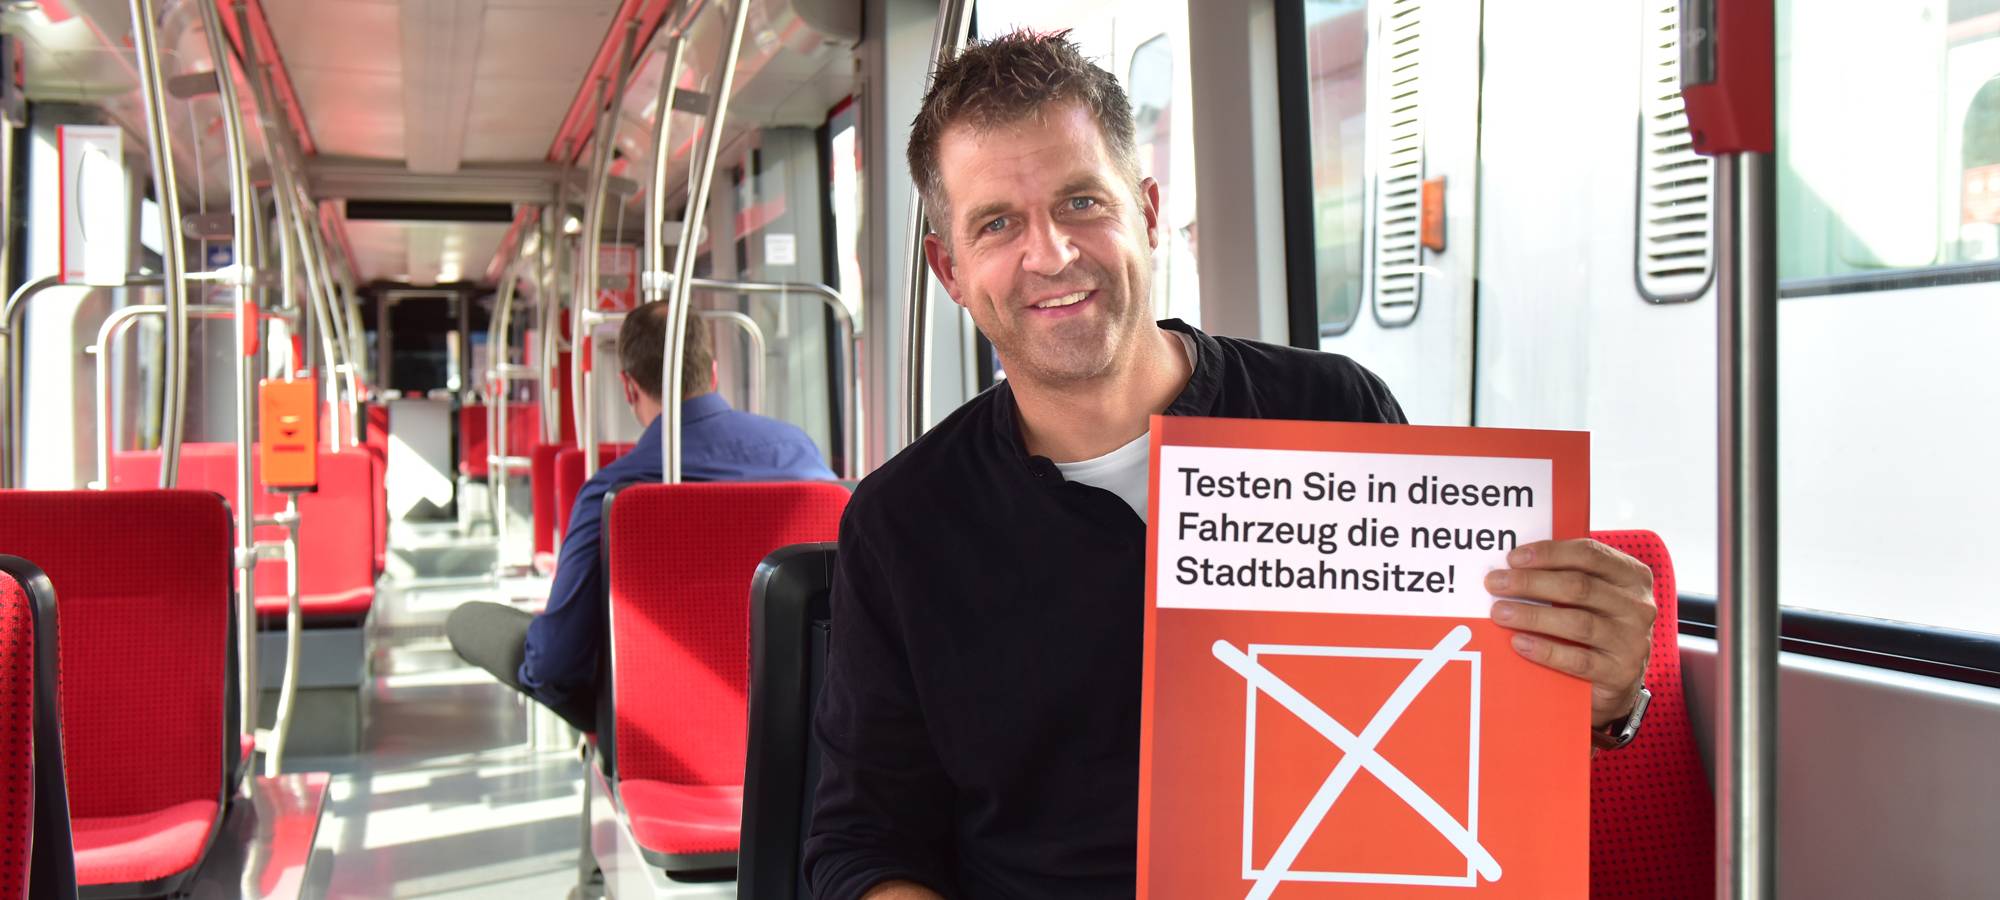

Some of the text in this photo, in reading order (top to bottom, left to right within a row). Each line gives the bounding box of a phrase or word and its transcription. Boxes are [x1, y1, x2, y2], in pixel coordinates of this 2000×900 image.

[1177, 467, 1534, 508] Testen Sie in diesem
[1178, 511, 1517, 555] Fahrzeug die neuen
[1175, 555, 1455, 594] Stadtbahnsitze!
